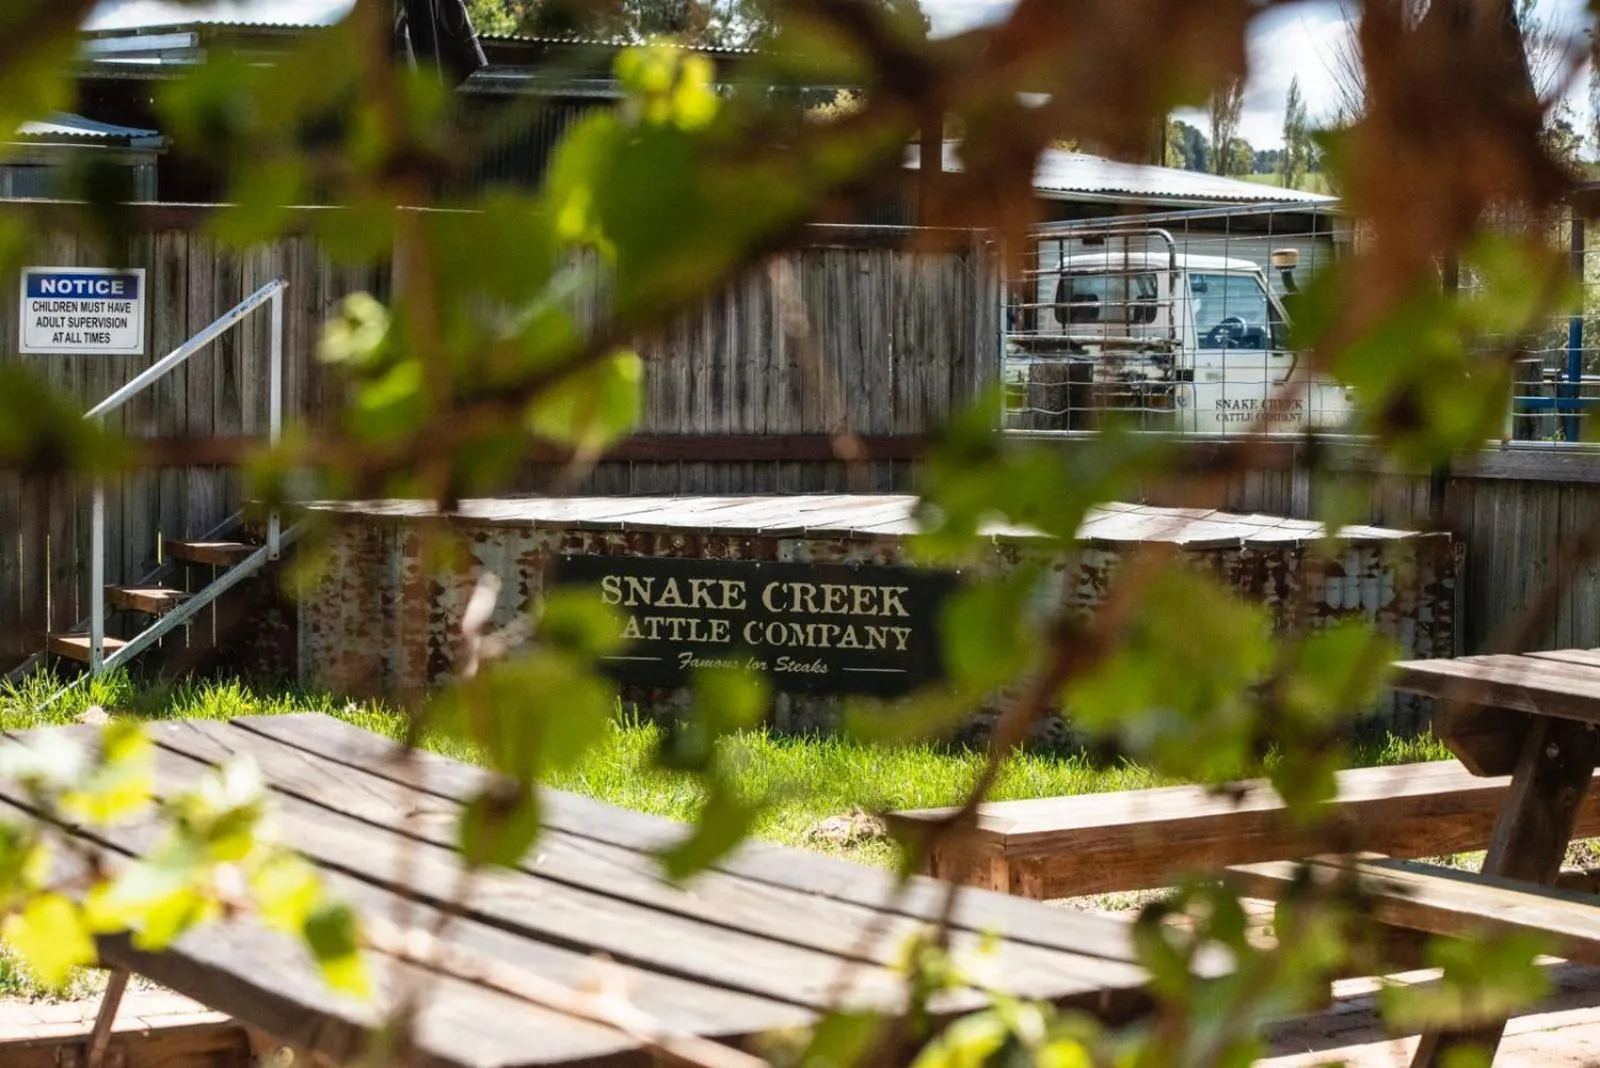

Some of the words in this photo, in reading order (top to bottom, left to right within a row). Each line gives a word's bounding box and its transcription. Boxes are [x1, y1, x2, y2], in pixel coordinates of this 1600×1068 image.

[40, 279, 125, 294] NOTICE
[32, 301, 78, 313] CHILDREN
[80, 301, 105, 313] MUST
[107, 302, 131, 313] HAVE
[36, 316, 66, 328] ADULT
[68, 317, 127, 328] SUPERVISION
[52, 332, 63, 343] AT
[64, 332, 82, 343] ALL
[84, 332, 111, 344] TIMES
[1215, 399, 1258, 410] SNAKE
[1216, 412, 1254, 422] CATTLE
[600, 575, 747, 610] SNAKE
[762, 581, 911, 618] CREEK
[608, 616, 730, 642] ATTLE
[743, 621, 913, 651] COMPANY
[677, 651, 739, 671] Famous
[774, 657, 830, 675] Steaks
